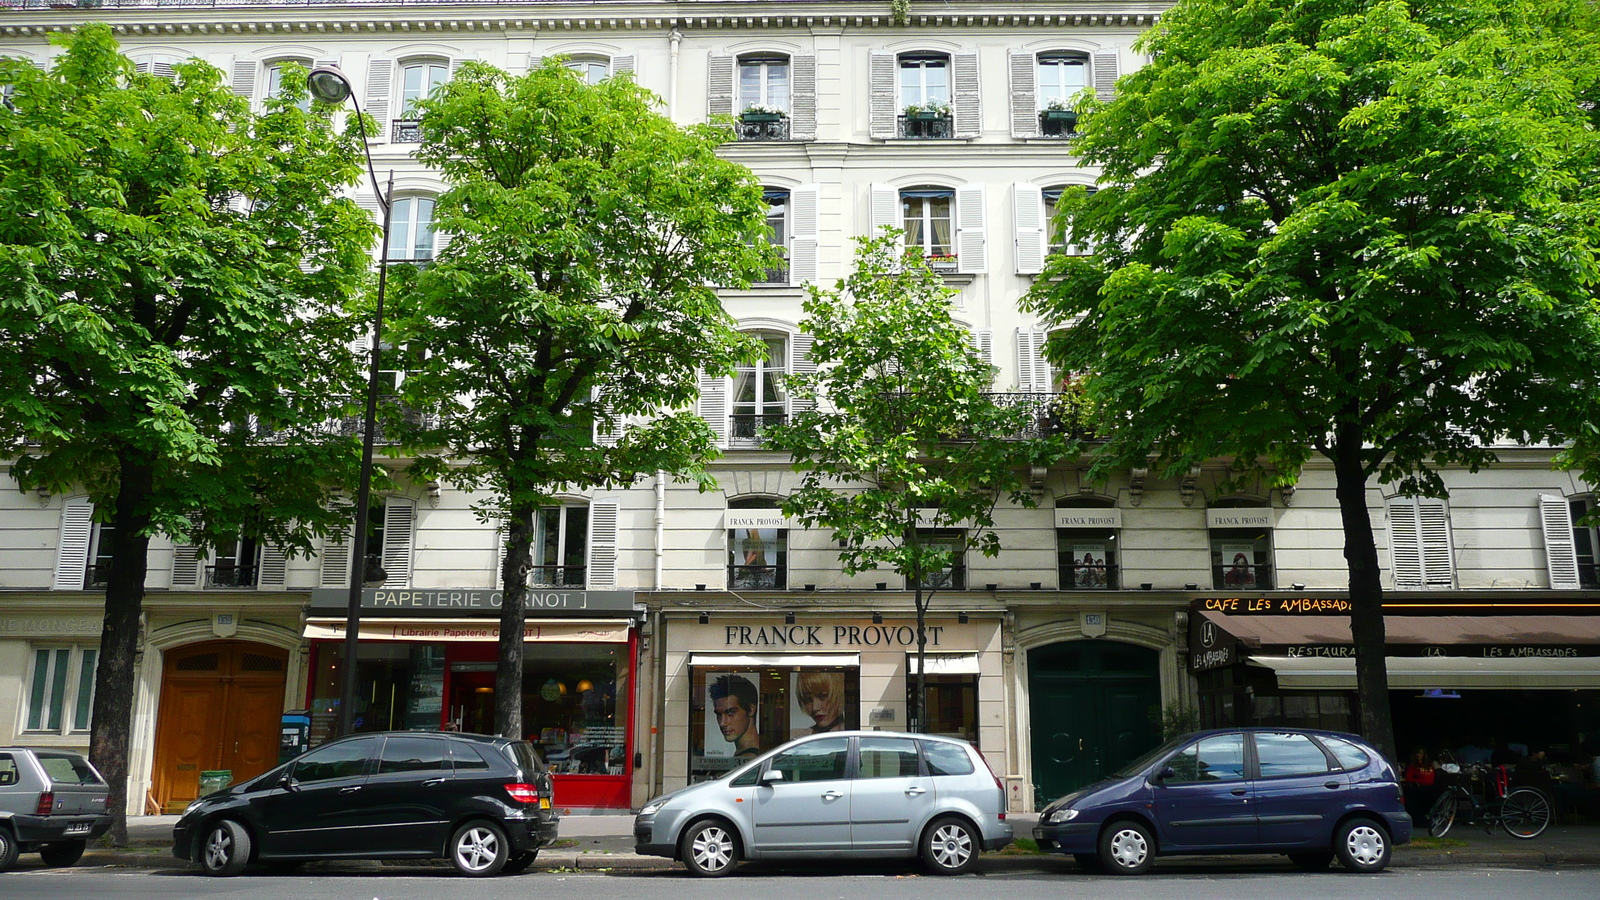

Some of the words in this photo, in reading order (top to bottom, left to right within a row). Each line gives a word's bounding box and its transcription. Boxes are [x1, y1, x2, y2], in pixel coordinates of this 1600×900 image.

[730, 517, 754, 526] FRANCK
[756, 517, 783, 526] PROVOST
[1061, 516, 1086, 525] FRANCK
[1088, 516, 1115, 525] PROVOST
[1214, 516, 1240, 525] FRANCK
[1241, 516, 1269, 525] PROVOST
[374, 591, 481, 607] PAPETERIE
[490, 592, 570, 608] CNOT
[1248, 598, 1271, 611] LES
[1280, 598, 1352, 613] AMBASSAD
[23, 619, 103, 632] MONCEA
[1086, 614, 1100, 625] 150
[401, 627, 440, 637] Librairie
[443, 627, 487, 639] Papeterie
[724, 625, 824, 646] FRANCK
[1203, 623, 1215, 644] LA
[1288, 646, 1356, 658] RESTAURA
[1427, 647, 1441, 658] LA
[1483, 647, 1503, 658] LES
[1508, 646, 1578, 658] AMBASSADES
